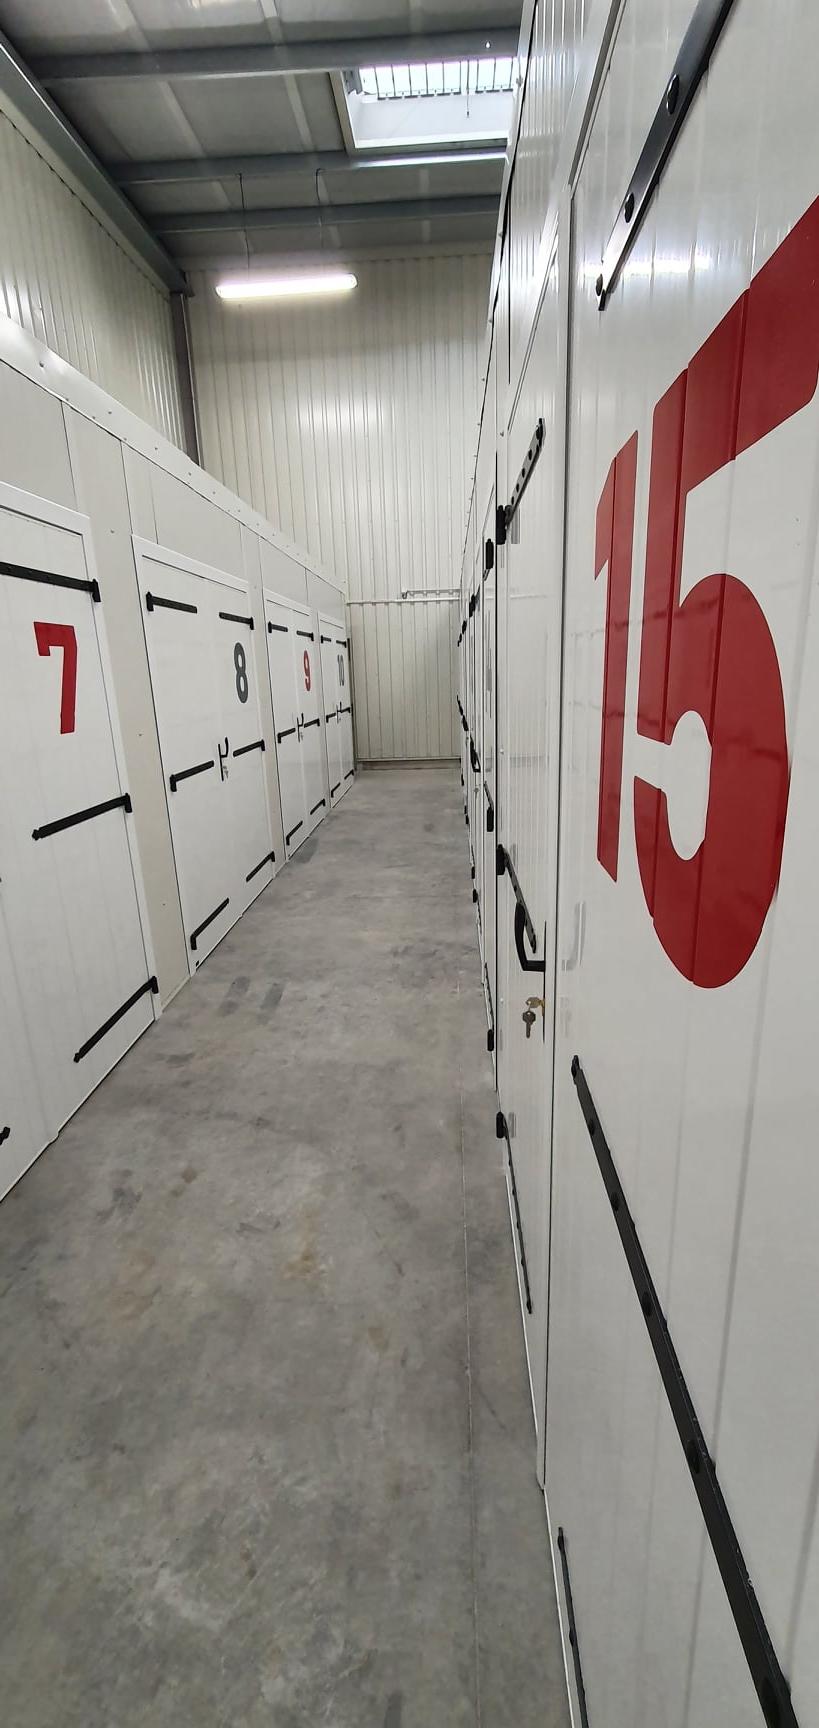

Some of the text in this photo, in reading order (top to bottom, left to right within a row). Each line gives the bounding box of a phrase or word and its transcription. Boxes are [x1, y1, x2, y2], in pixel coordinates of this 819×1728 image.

[595, 196, 819, 988] 15
[34, 621, 77, 734] 7
[234, 642, 249, 704] 8
[303, 650, 311, 691] 9
